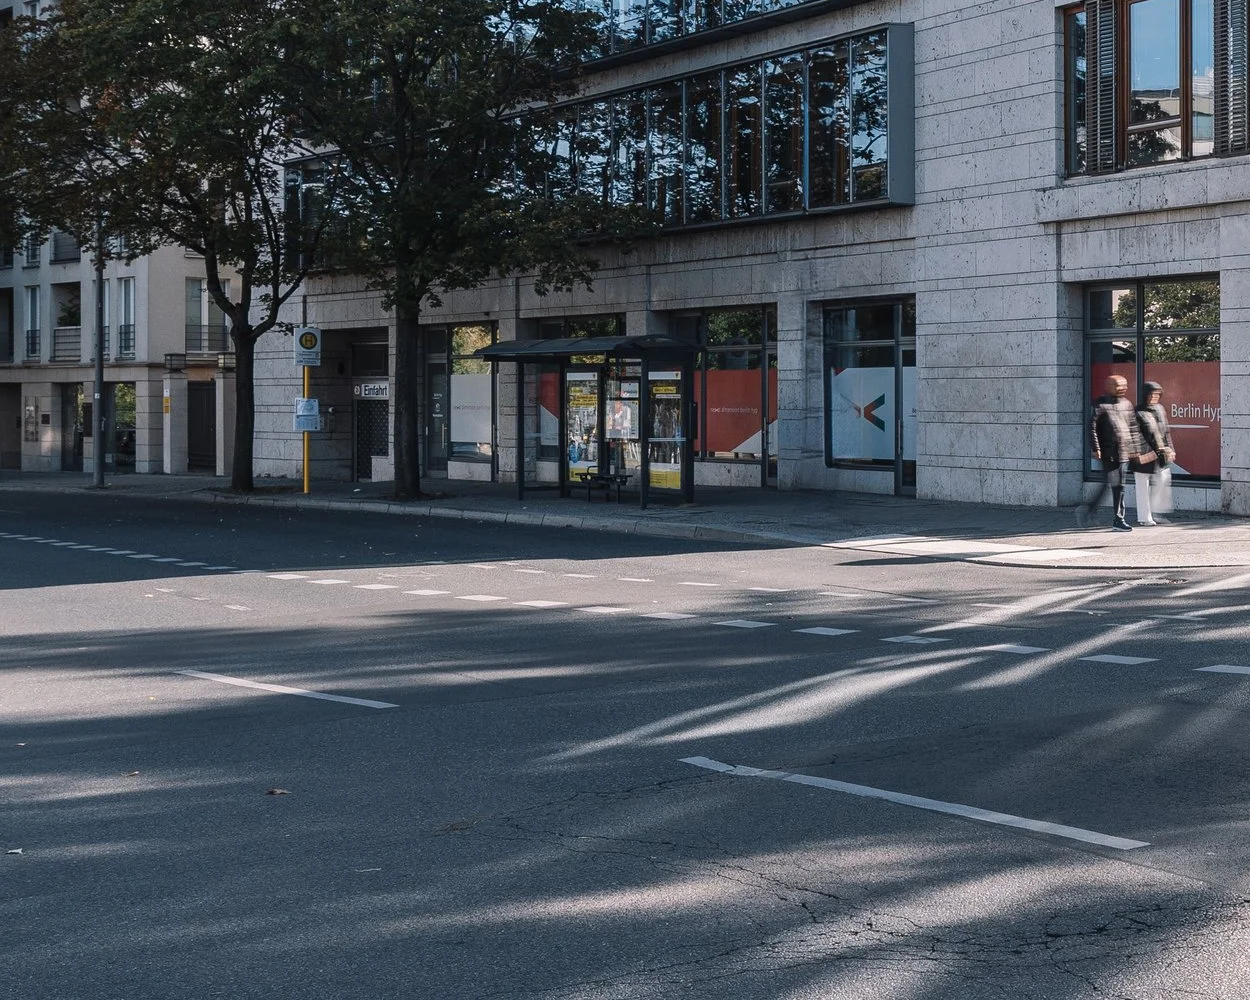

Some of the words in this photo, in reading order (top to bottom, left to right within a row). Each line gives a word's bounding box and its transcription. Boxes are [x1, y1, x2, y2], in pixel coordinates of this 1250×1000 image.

[364, 384, 388, 396] Einfahrt
[1171, 403, 1200, 418] Berlin
[1203, 403, 1222, 422] Hyp
